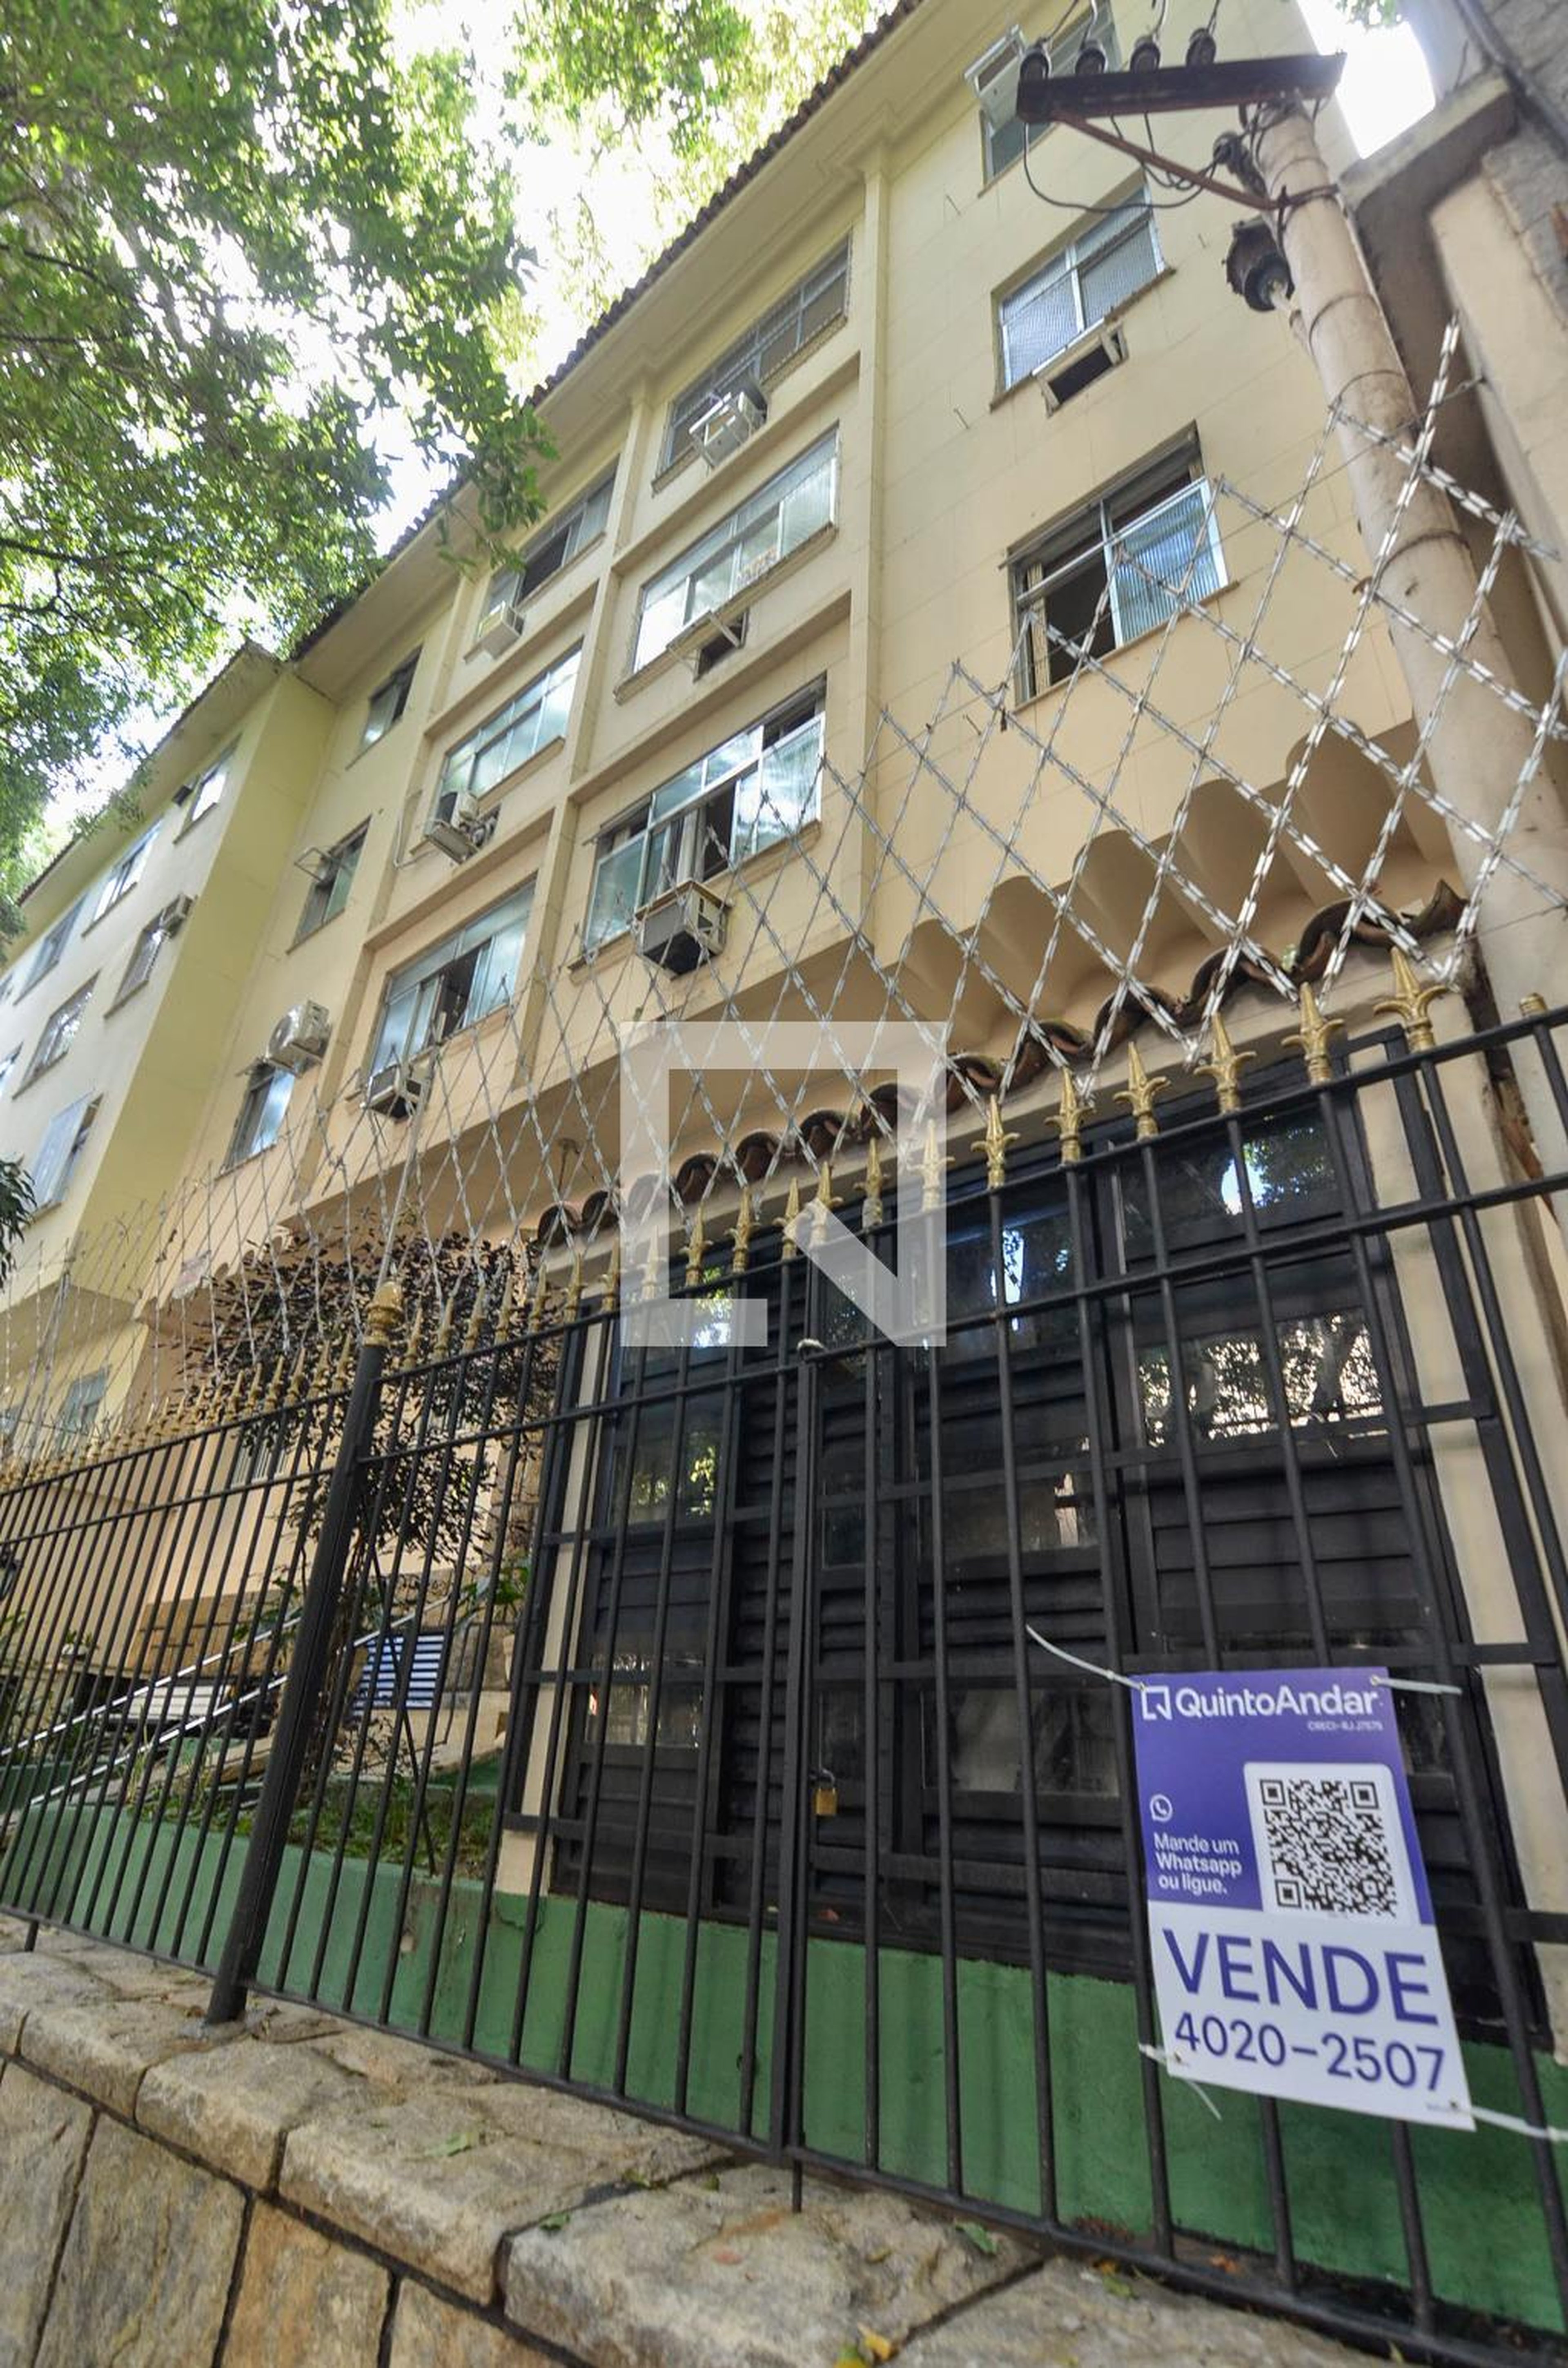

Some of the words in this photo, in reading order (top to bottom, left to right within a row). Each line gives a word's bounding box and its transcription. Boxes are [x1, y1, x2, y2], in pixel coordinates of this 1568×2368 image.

[1175, 1684, 1379, 1718] QuintoAndar
[1154, 1832, 1210, 1853] Mande
[1212, 1839, 1240, 1855] um
[1155, 1851, 1242, 1879] Whatsapp
[1158, 1874, 1180, 1890] ou
[1181, 1873, 1227, 1896] ligue.
[1162, 1928, 1439, 2026] VENDE
[1175, 2012, 1445, 2091] 4020-2507
